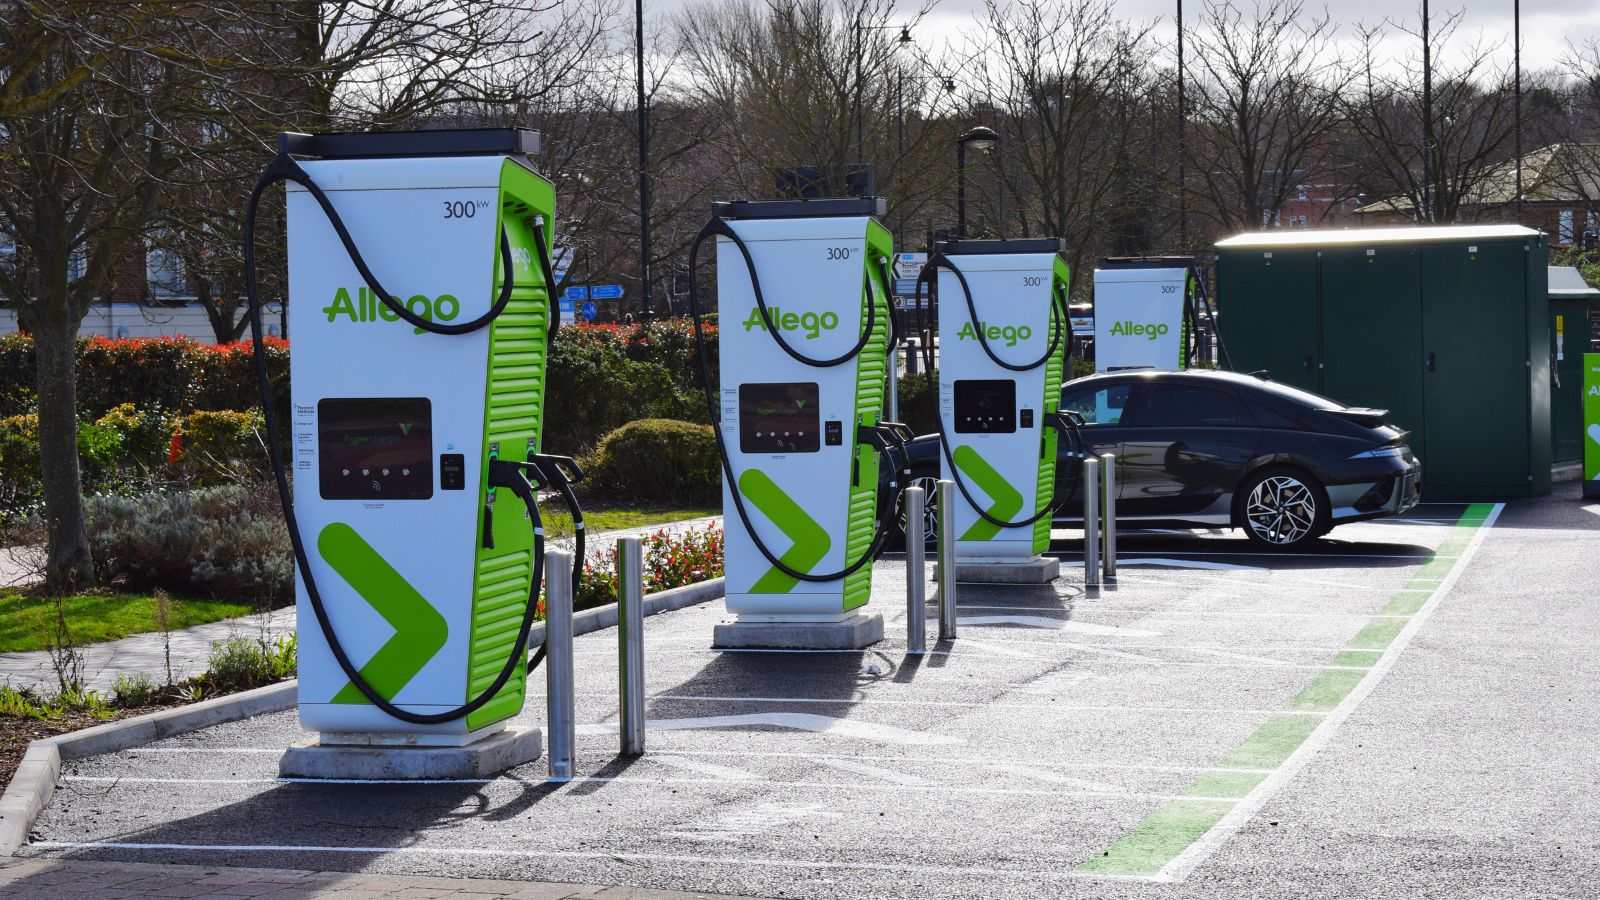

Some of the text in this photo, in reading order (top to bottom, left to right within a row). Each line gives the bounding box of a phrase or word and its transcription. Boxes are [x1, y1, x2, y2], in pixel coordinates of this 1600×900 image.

[323, 287, 460, 335] Allego
[742, 307, 839, 340] Allego
[957, 321, 1032, 347] Allego
[1109, 320, 1169, 341] Allego
